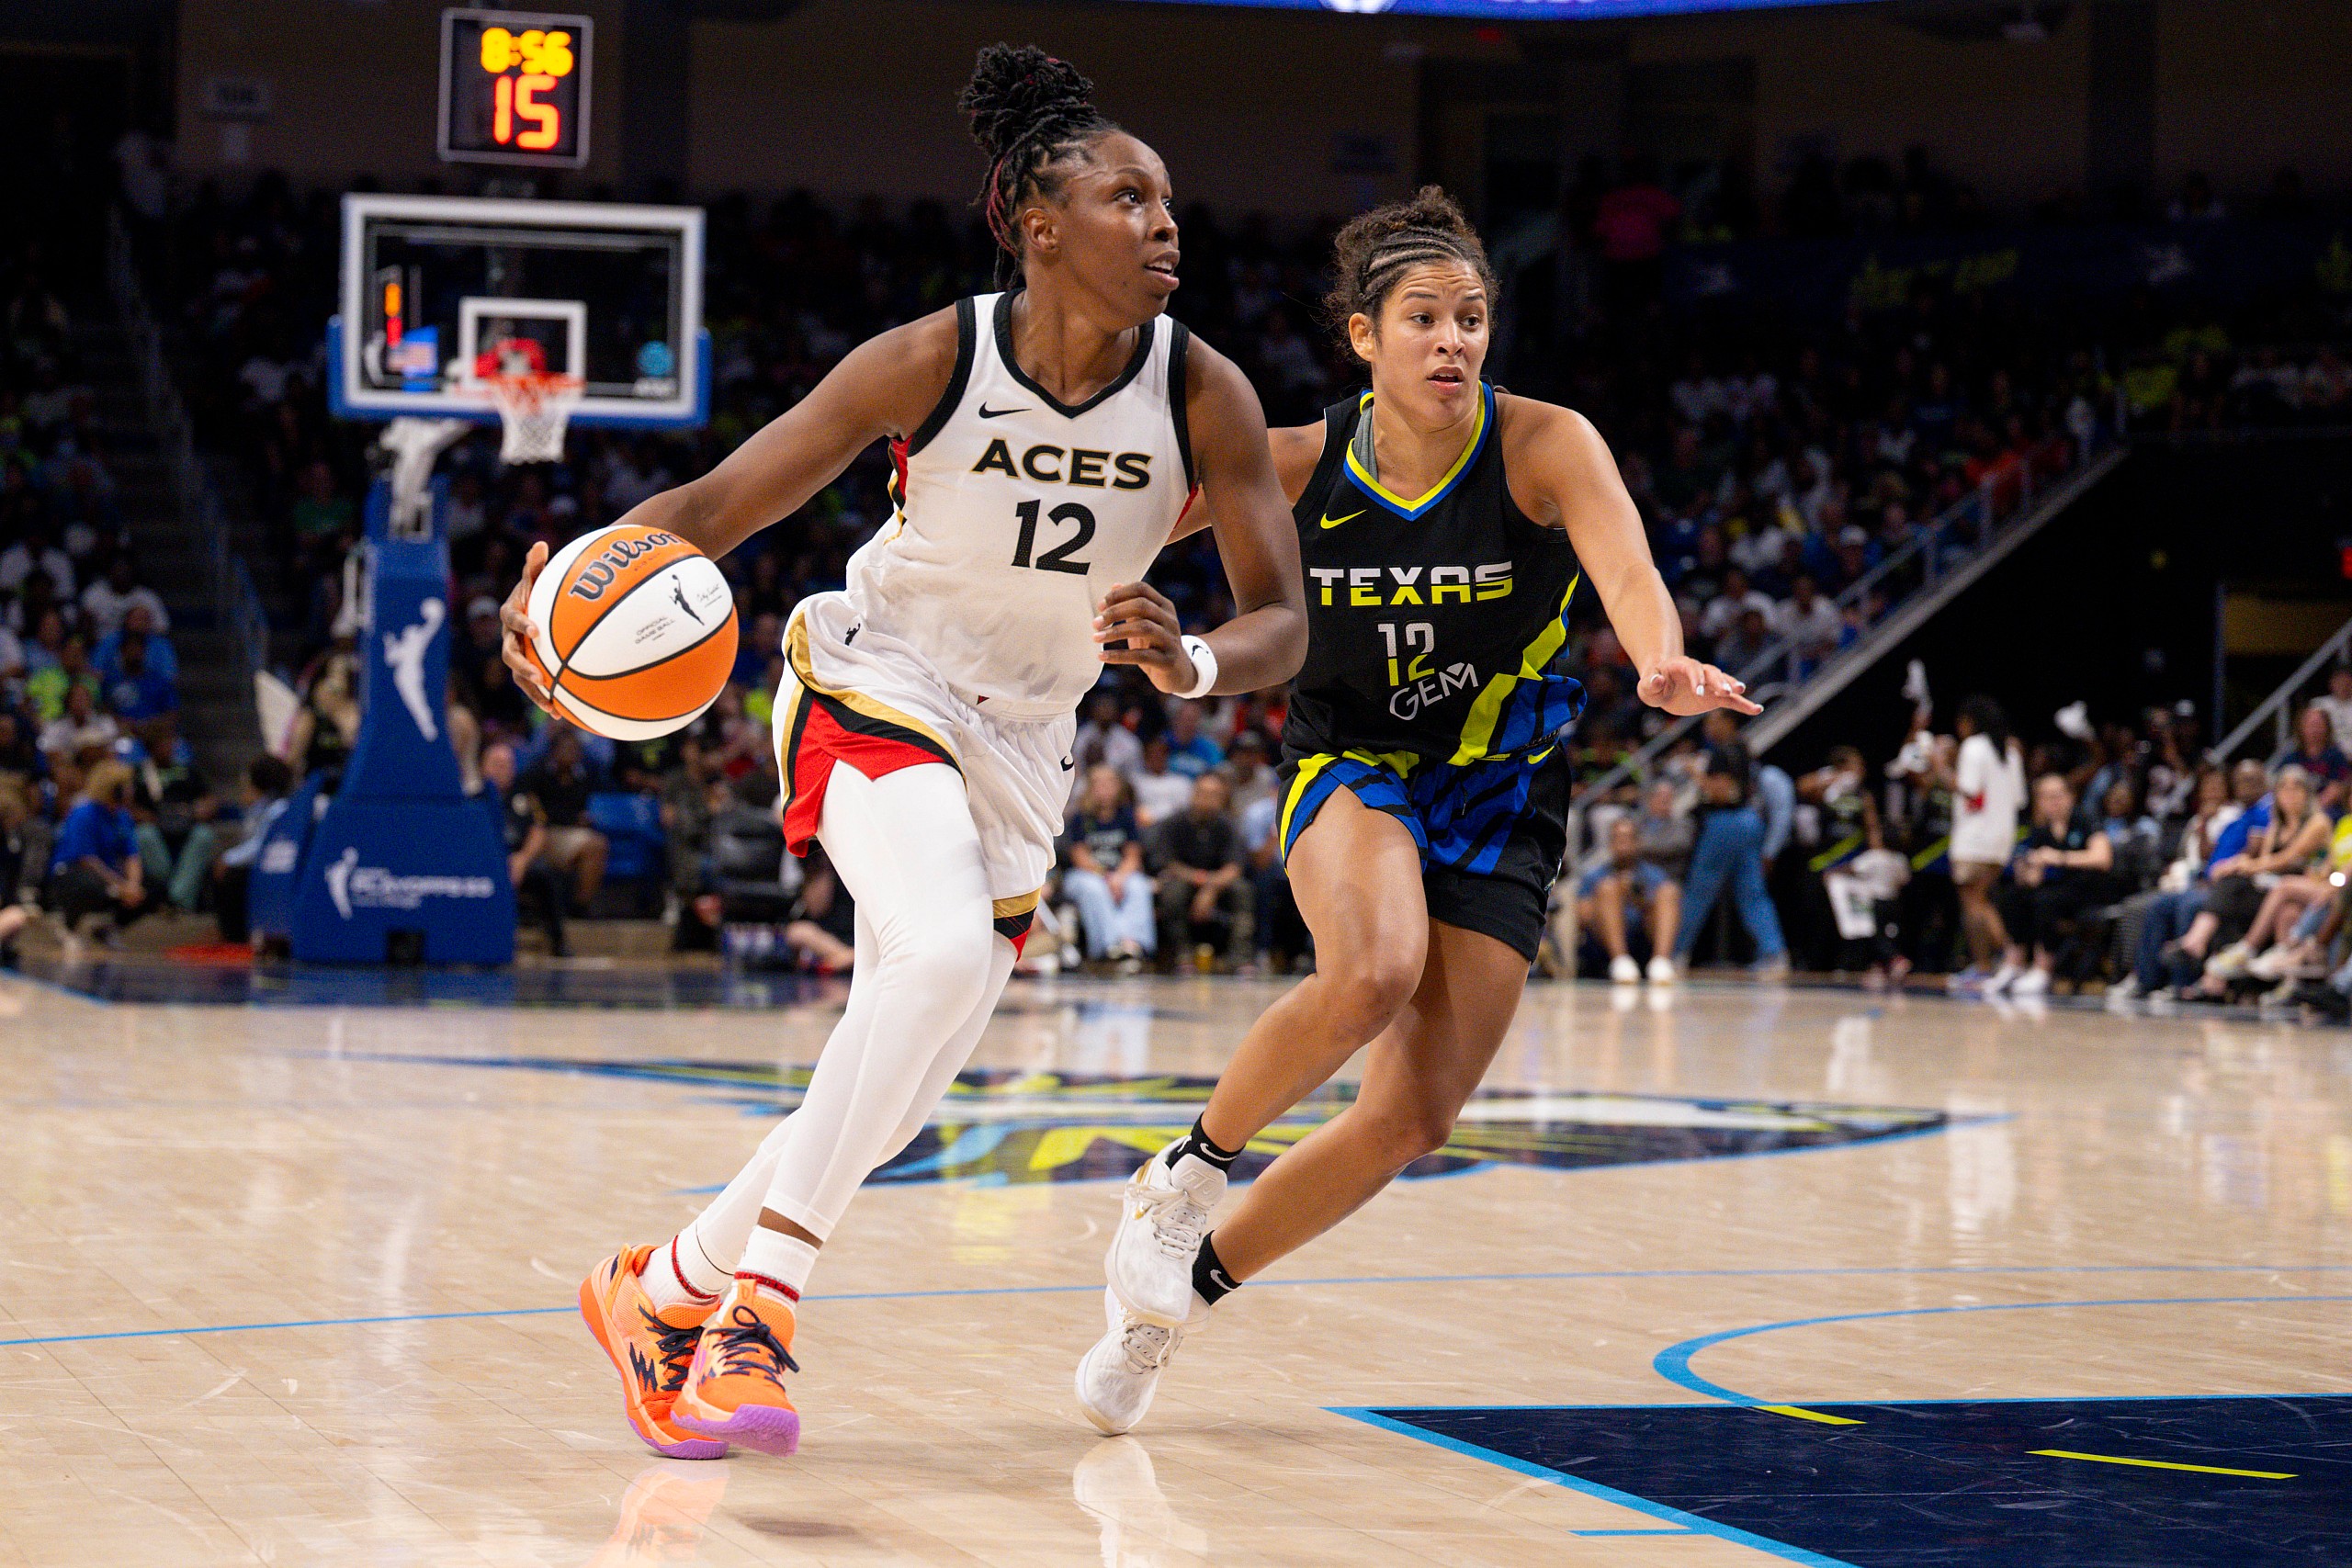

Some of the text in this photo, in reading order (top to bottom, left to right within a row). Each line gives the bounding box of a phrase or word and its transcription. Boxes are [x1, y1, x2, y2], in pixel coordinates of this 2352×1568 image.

[481, 28, 573, 77] 8:56
[493, 74, 560, 150] 15
[969, 437, 1154, 491] ACES
[569, 532, 687, 601] Wilson
[1011, 499, 1096, 575] 12
[1309, 560, 1513, 606] TEXAS
[1377, 622, 1435, 686] 12
[1389, 661, 1479, 721] GEM
